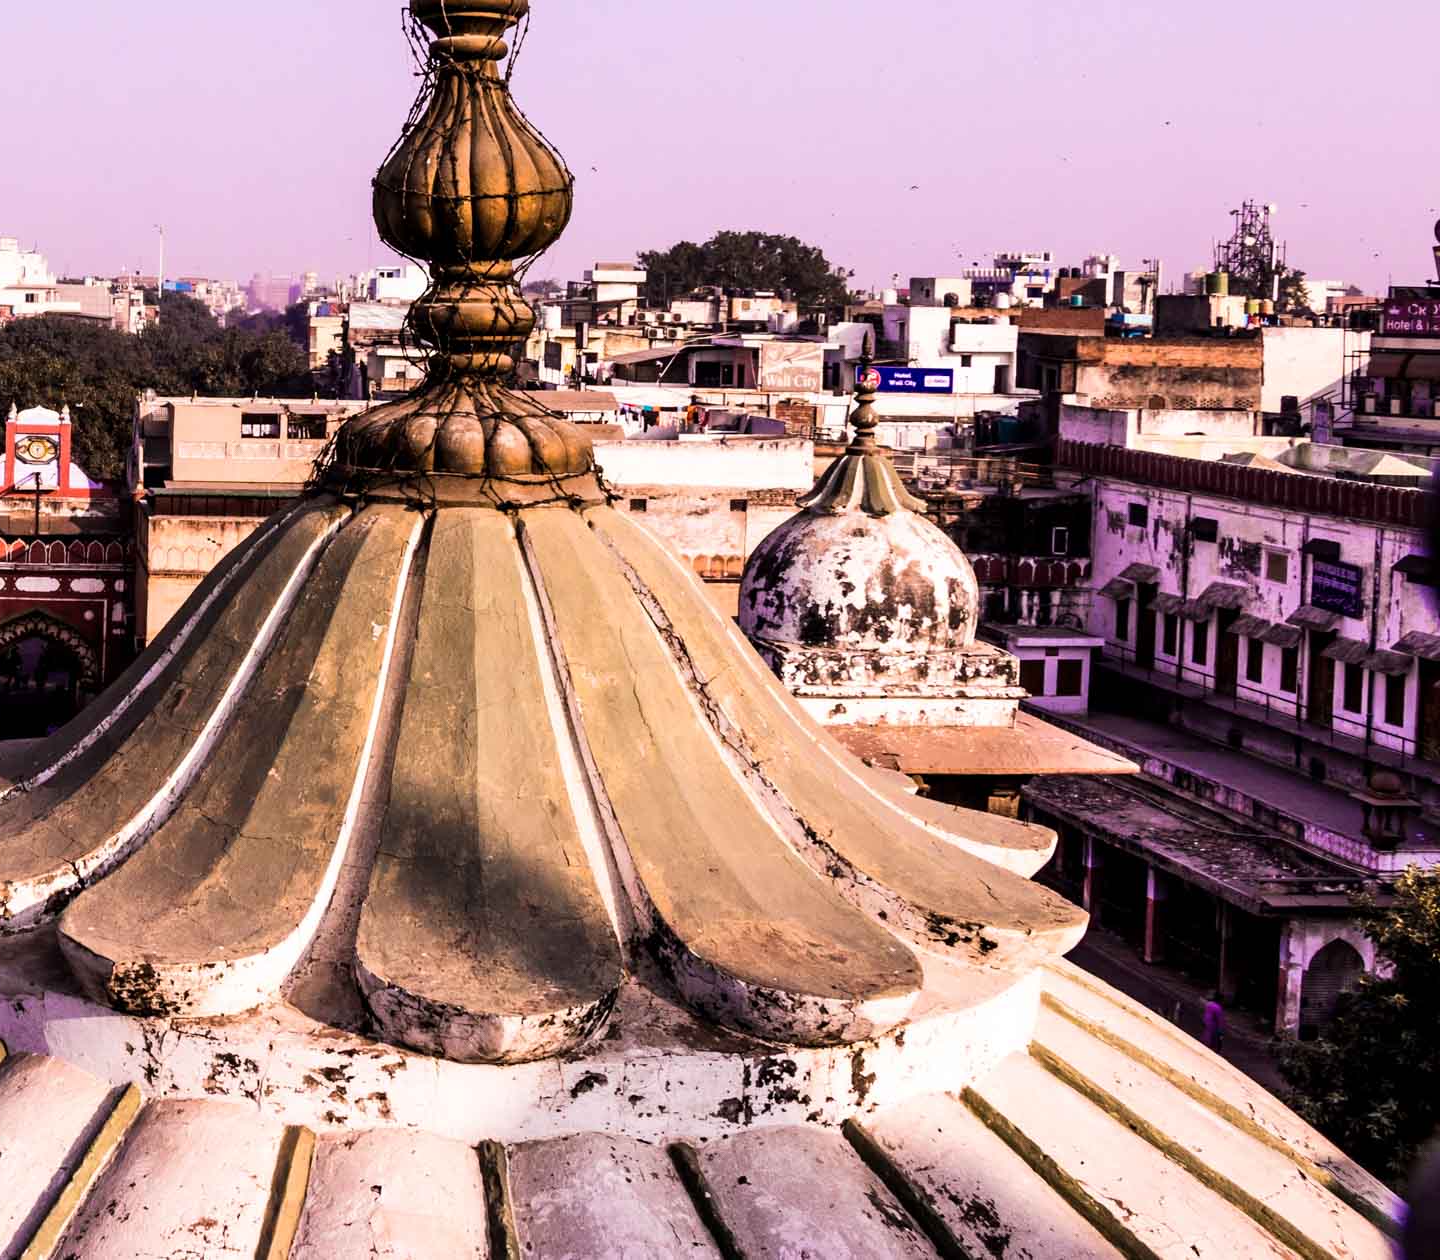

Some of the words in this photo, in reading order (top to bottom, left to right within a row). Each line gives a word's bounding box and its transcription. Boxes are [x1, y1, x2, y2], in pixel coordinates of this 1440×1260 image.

[1408, 303, 1440, 316] CR
[1387, 320, 1414, 330] Hotel
[1415, 320, 1424, 330] &
[765, 374, 791, 387] Wall
[793, 374, 817, 389] City
[904, 379, 917, 387] City
